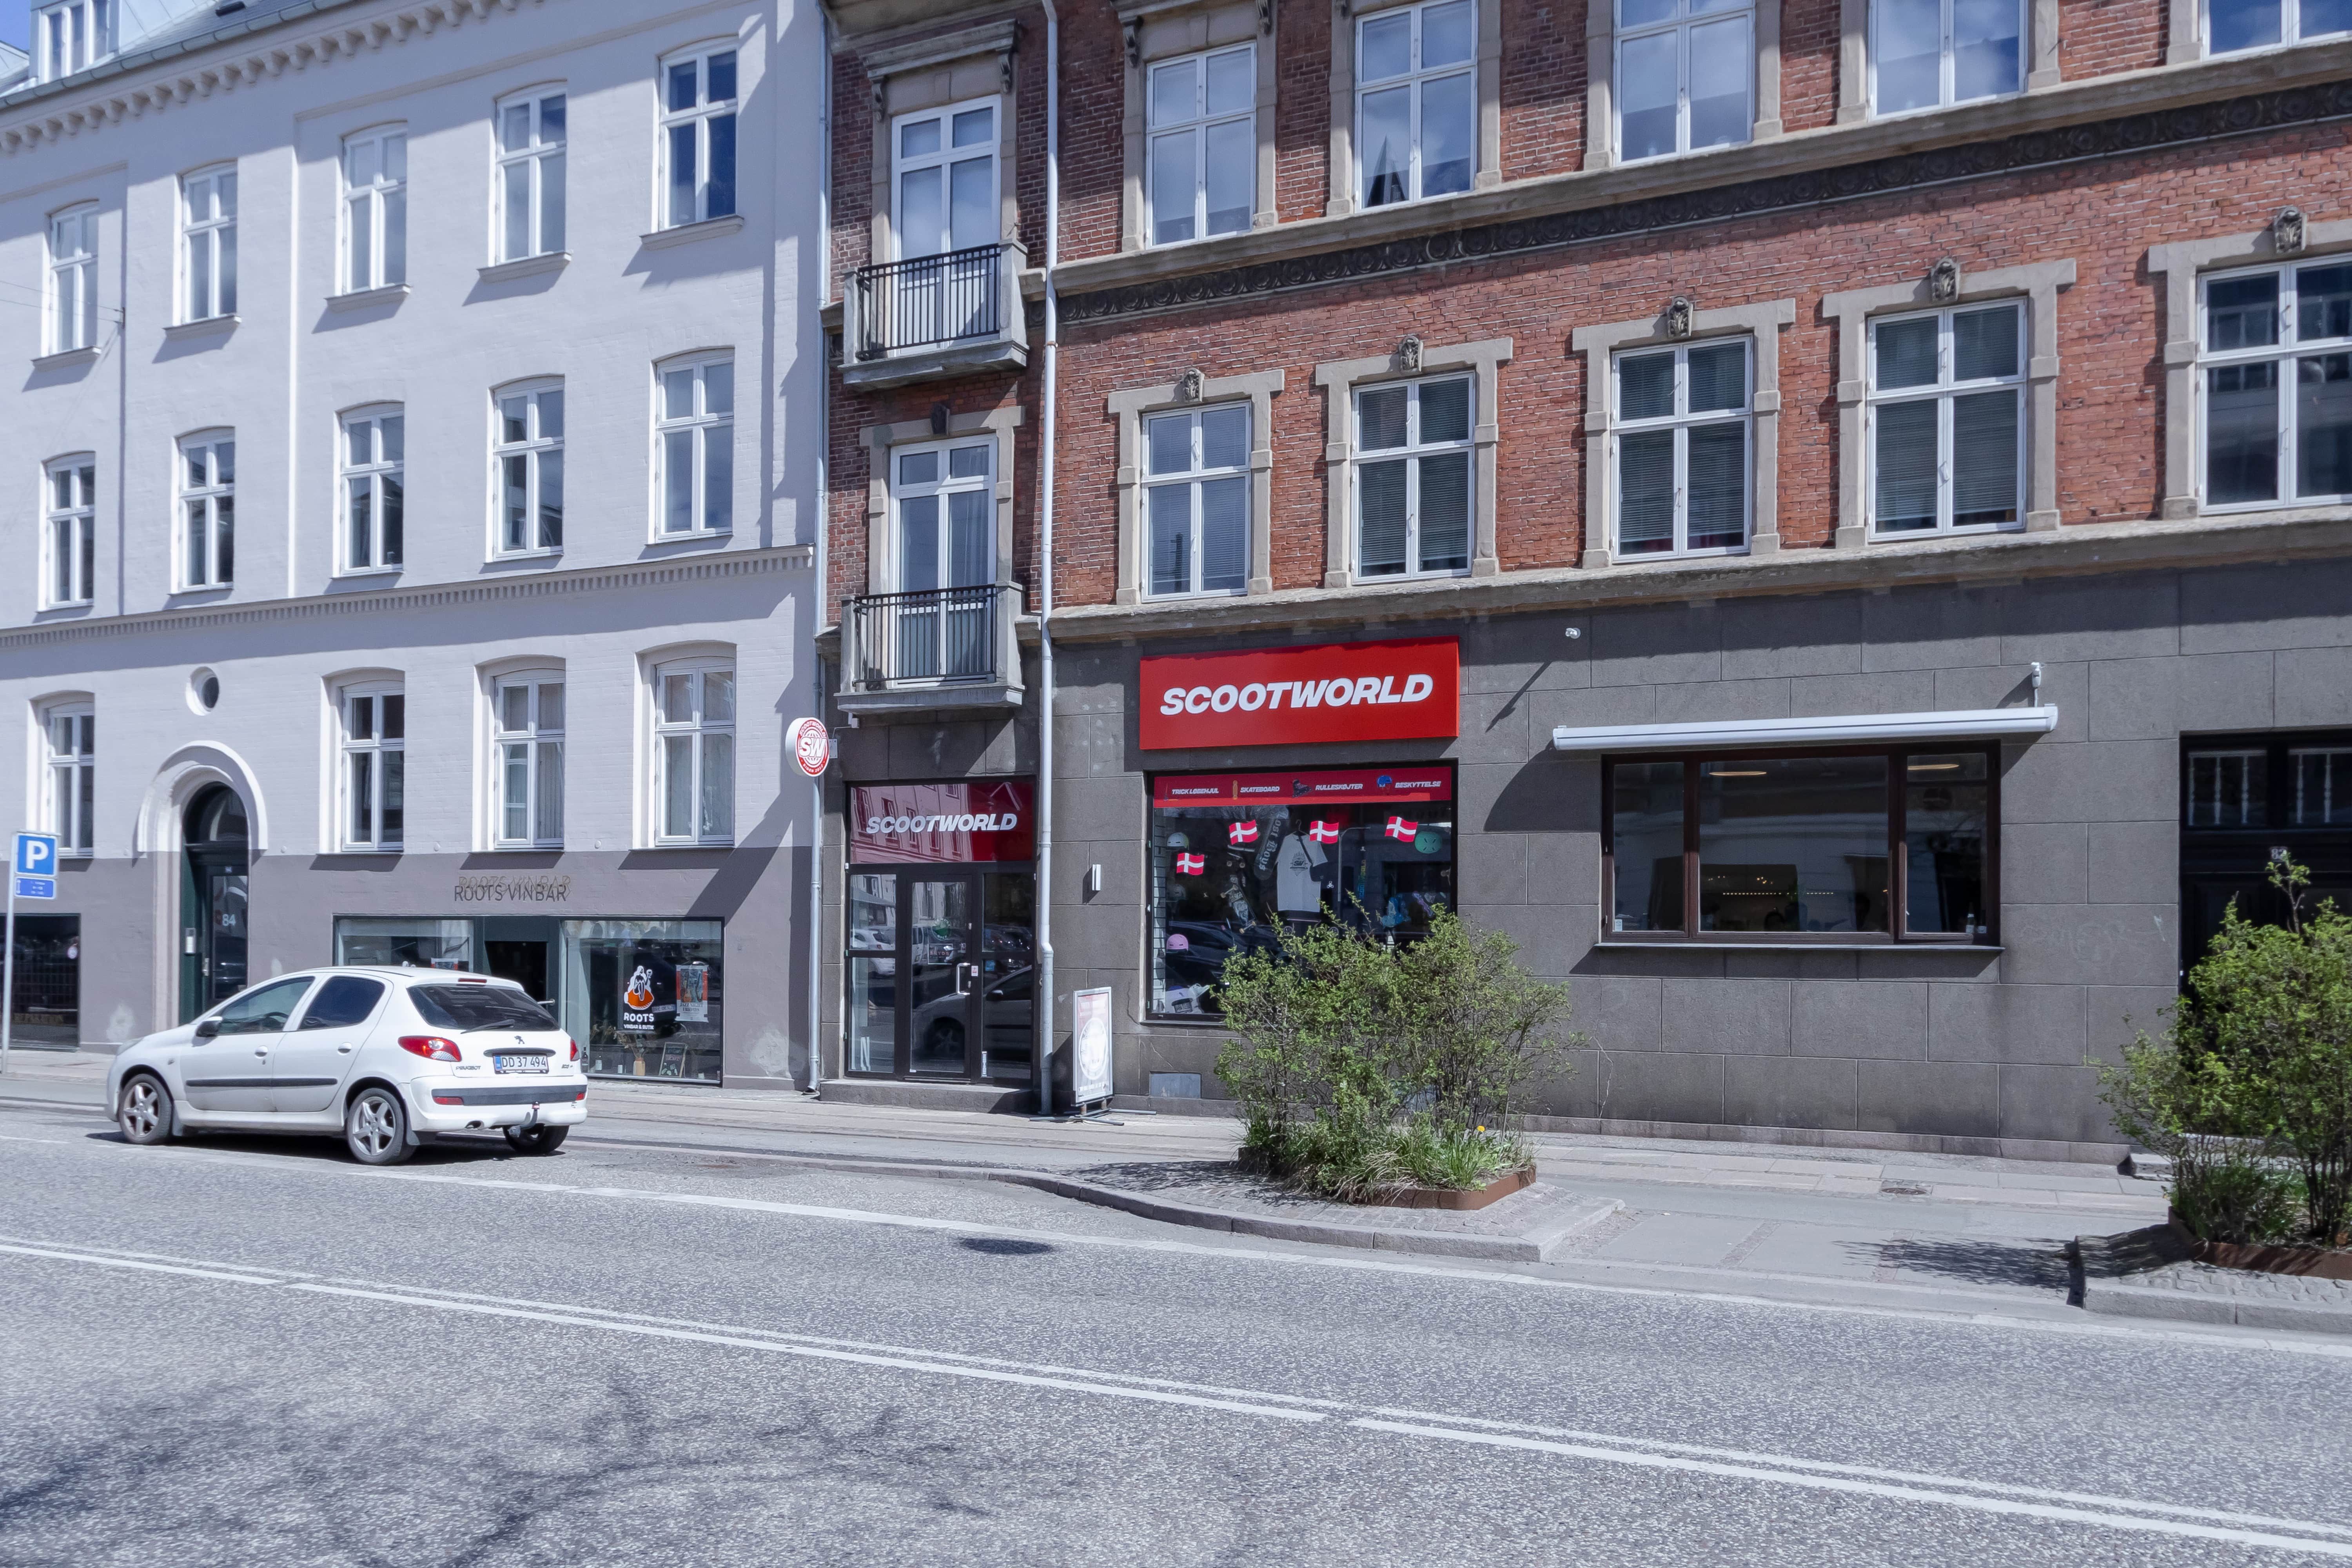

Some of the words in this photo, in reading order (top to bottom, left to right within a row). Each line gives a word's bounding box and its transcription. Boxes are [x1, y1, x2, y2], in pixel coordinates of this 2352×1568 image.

[1160, 674, 1433, 715] SCOOTWORLD
[799, 737, 827, 757] SW
[866, 813, 1017, 834] SCOOTWORLD
[26, 840, 49, 869] P
[222, 914, 236, 926] 84
[624, 1013, 654, 1022] ROOTS
[502, 1057, 515, 1067] DD
[517, 1057, 527, 1067] 37
[530, 1056, 546, 1067] 494
